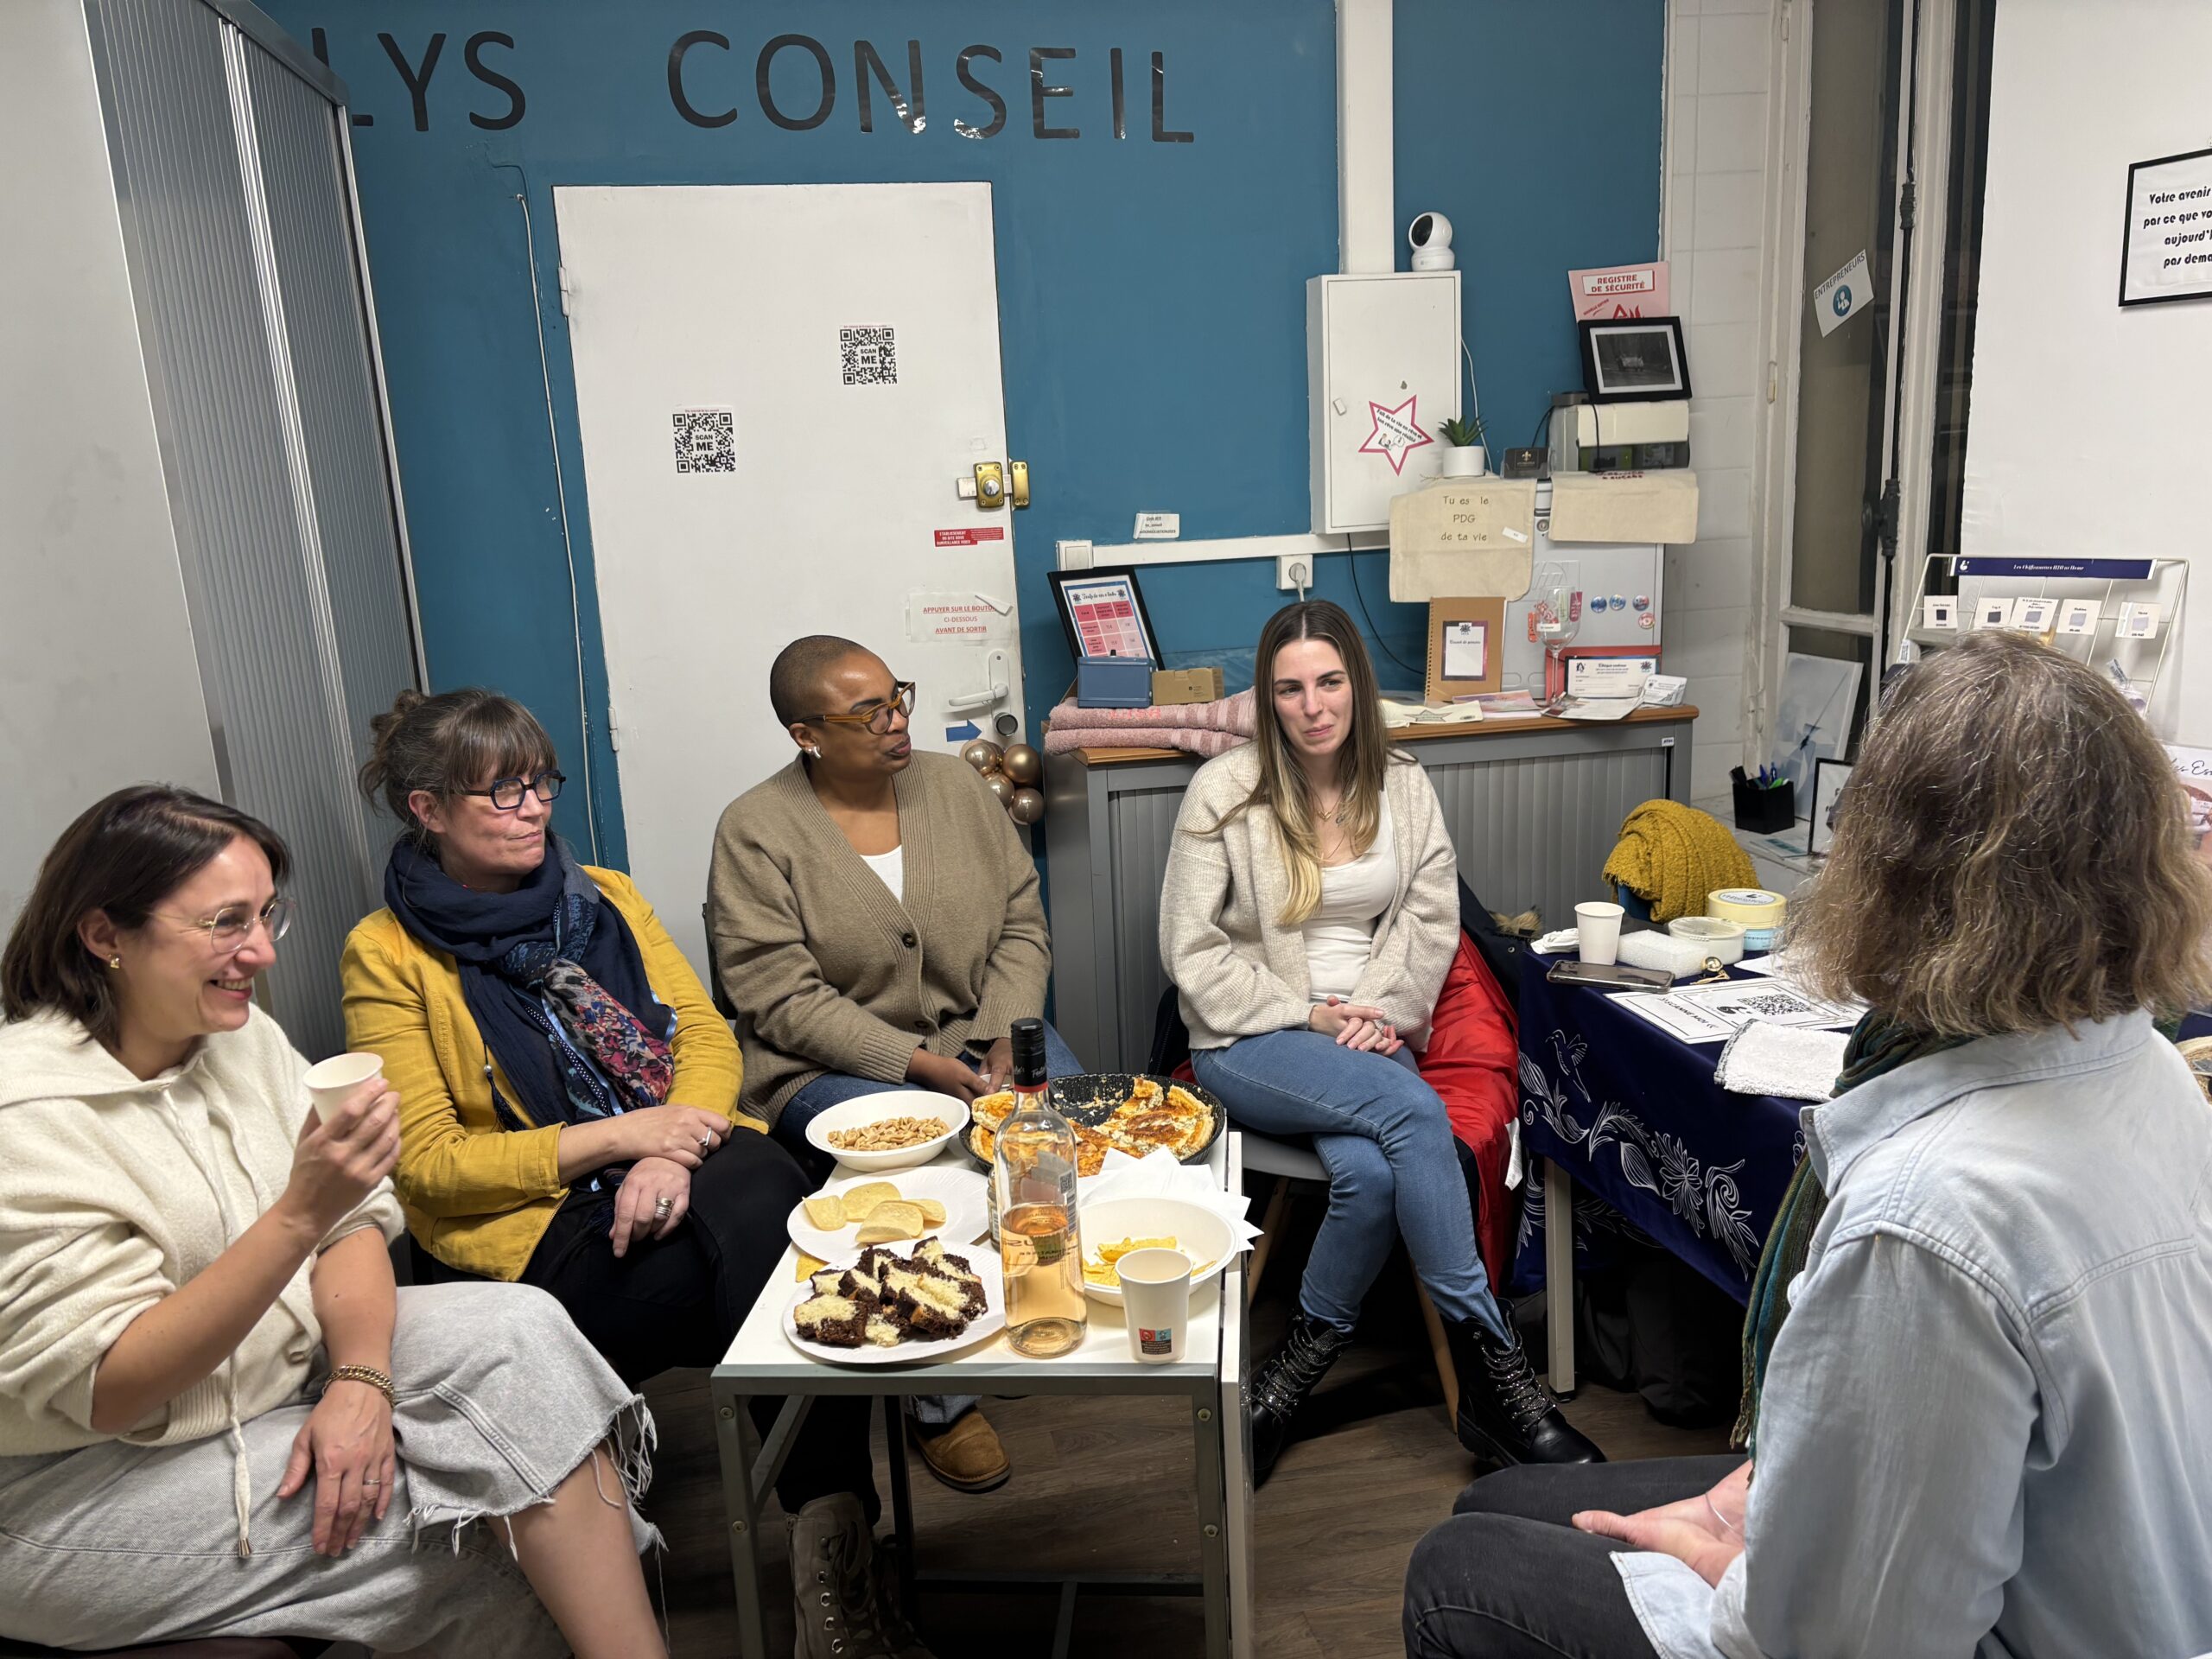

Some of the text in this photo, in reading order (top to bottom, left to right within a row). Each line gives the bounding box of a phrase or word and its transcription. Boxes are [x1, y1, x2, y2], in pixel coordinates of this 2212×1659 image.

[667, 30, 1194, 143] CONSEIL
[2149, 186, 2212, 205] Votre avenir
[2143, 217, 2161, 229] par
[2163, 215, 2176, 224] ce
[2178, 212, 2198, 225] que
[2164, 257, 2182, 269] pas
[1597, 274, 1637, 284] REGISTRE
[1815, 252, 1866, 300] ENTREPRENEURS
[1605, 280, 1645, 292] SÉCURITÉ
[861, 355, 877, 364] ME
[696, 442, 714, 451] ME
[1442, 495, 1455, 505] Tu
[1480, 496, 1489, 505] le
[1452, 513, 1476, 523] PDG
[1440, 532, 1452, 541] de
[1472, 532, 1487, 541] vie
